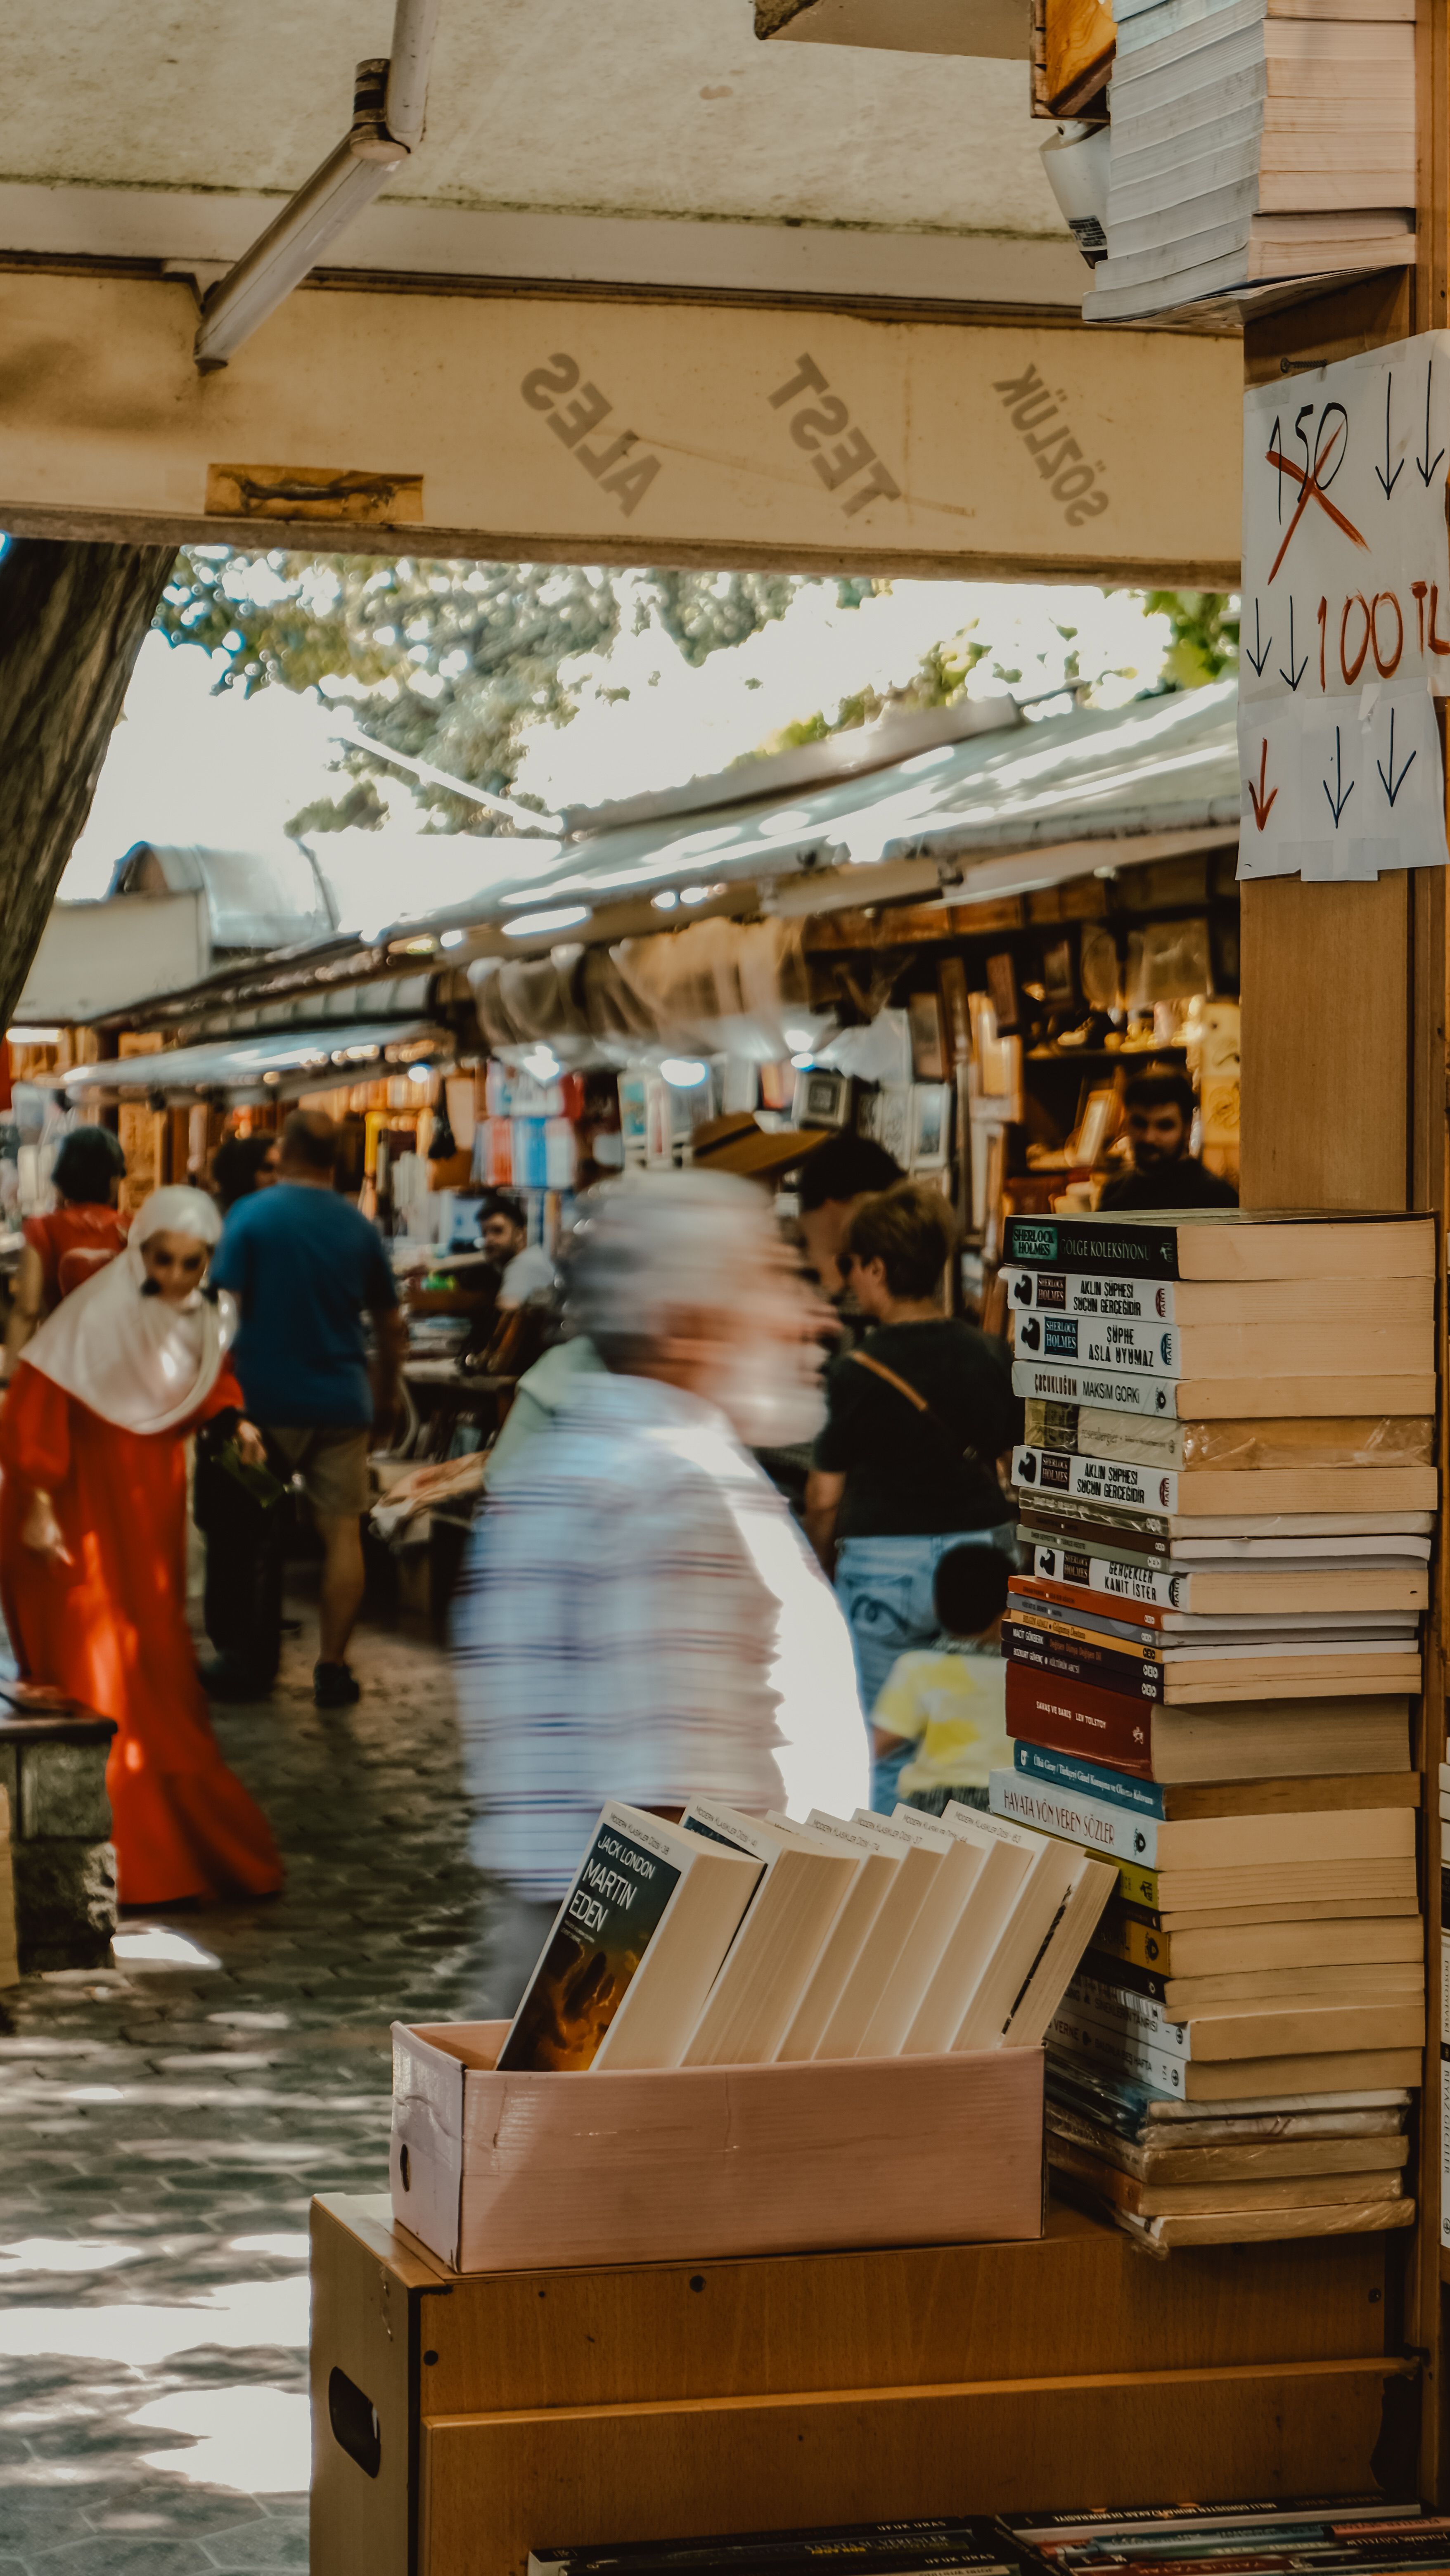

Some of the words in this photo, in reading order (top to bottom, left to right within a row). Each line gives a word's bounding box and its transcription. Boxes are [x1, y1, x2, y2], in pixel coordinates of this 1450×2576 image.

[1013, 1229, 1054, 1243] SHERLOCK
[1018, 1242, 1050, 1255] HOLMES
[1059, 1236, 1088, 1257] GÖLGE
[1090, 1240, 1150, 1261] KOLEKSİYONU
[1038, 1279, 1064, 1289] SHERLOCK
[1080, 1280, 1102, 1295] AKLIN
[1104, 1280, 1134, 1299] ŞÜPHESİ
[1038, 1289, 1064, 1302] HOLMES
[1073, 1296, 1098, 1314] SUÇUN
[1100, 1299, 1142, 1317] GERÇEĞİDİR
[1046, 1321, 1076, 1334] SHERLOCK
[1106, 1324, 1135, 1345] ŞÜPHE
[1046, 1334, 1076, 1350] HOLMES
[1088, 1344, 1111, 1362] ASLA
[1115, 1347, 1154, 1368] UYUMAZ
[1083, 1380, 1114, 1400] MAKSİM
[1114, 1385, 1140, 1404] GORKİ
[1042, 1457, 1069, 1470] SHERLOCK
[1084, 1463, 1106, 1480] AKLIN
[1108, 1465, 1138, 1485] ŞÜPHESİ
[1042, 1468, 1069, 1483] HOLMES
[1076, 1478, 1102, 1497] SUÇUN
[1103, 1483, 1145, 1503] GERÇEĞİDİR
[1064, 1564, 1089, 1578] HOLMES
[1065, 1554, 1089, 1567] SHERLOCK
[1108, 1561, 1154, 1584] GERÇEKLER
[1104, 1576, 1130, 1594] KANIT
[1133, 1581, 1156, 1601] İSTER
[1013, 1627, 1025, 1639] MACİT
[1036, 1700, 1050, 1714] SAVAŞ
[1051, 1705, 1057, 1714] VE
[1058, 1707, 1072, 1720] BARIŞ
[1075, 1712, 1084, 1723] LEV
[1085, 1715, 1106, 1729] TOLSTOY
[1004, 1789, 1034, 1820] HAYATA
[1035, 1798, 1054, 1825] YÖN
[1056, 1807, 1081, 1837] VEREN
[1083, 1813, 1115, 1846] SÖZLER
[597, 1835, 623, 1860] JACK
[620, 1847, 656, 1880] LONDON
[583, 1859, 638, 1911] MARTIN
[569, 1889, 609, 1932] EDEN
[1054, 2019, 1080, 2041] VERNE
[1133, 2055, 1153, 2072] HAFTA
[913, 2520, 947, 2529] URAS
[924, 2556, 959, 2565] UFUK
[961, 2553, 995, 2562] URAS
